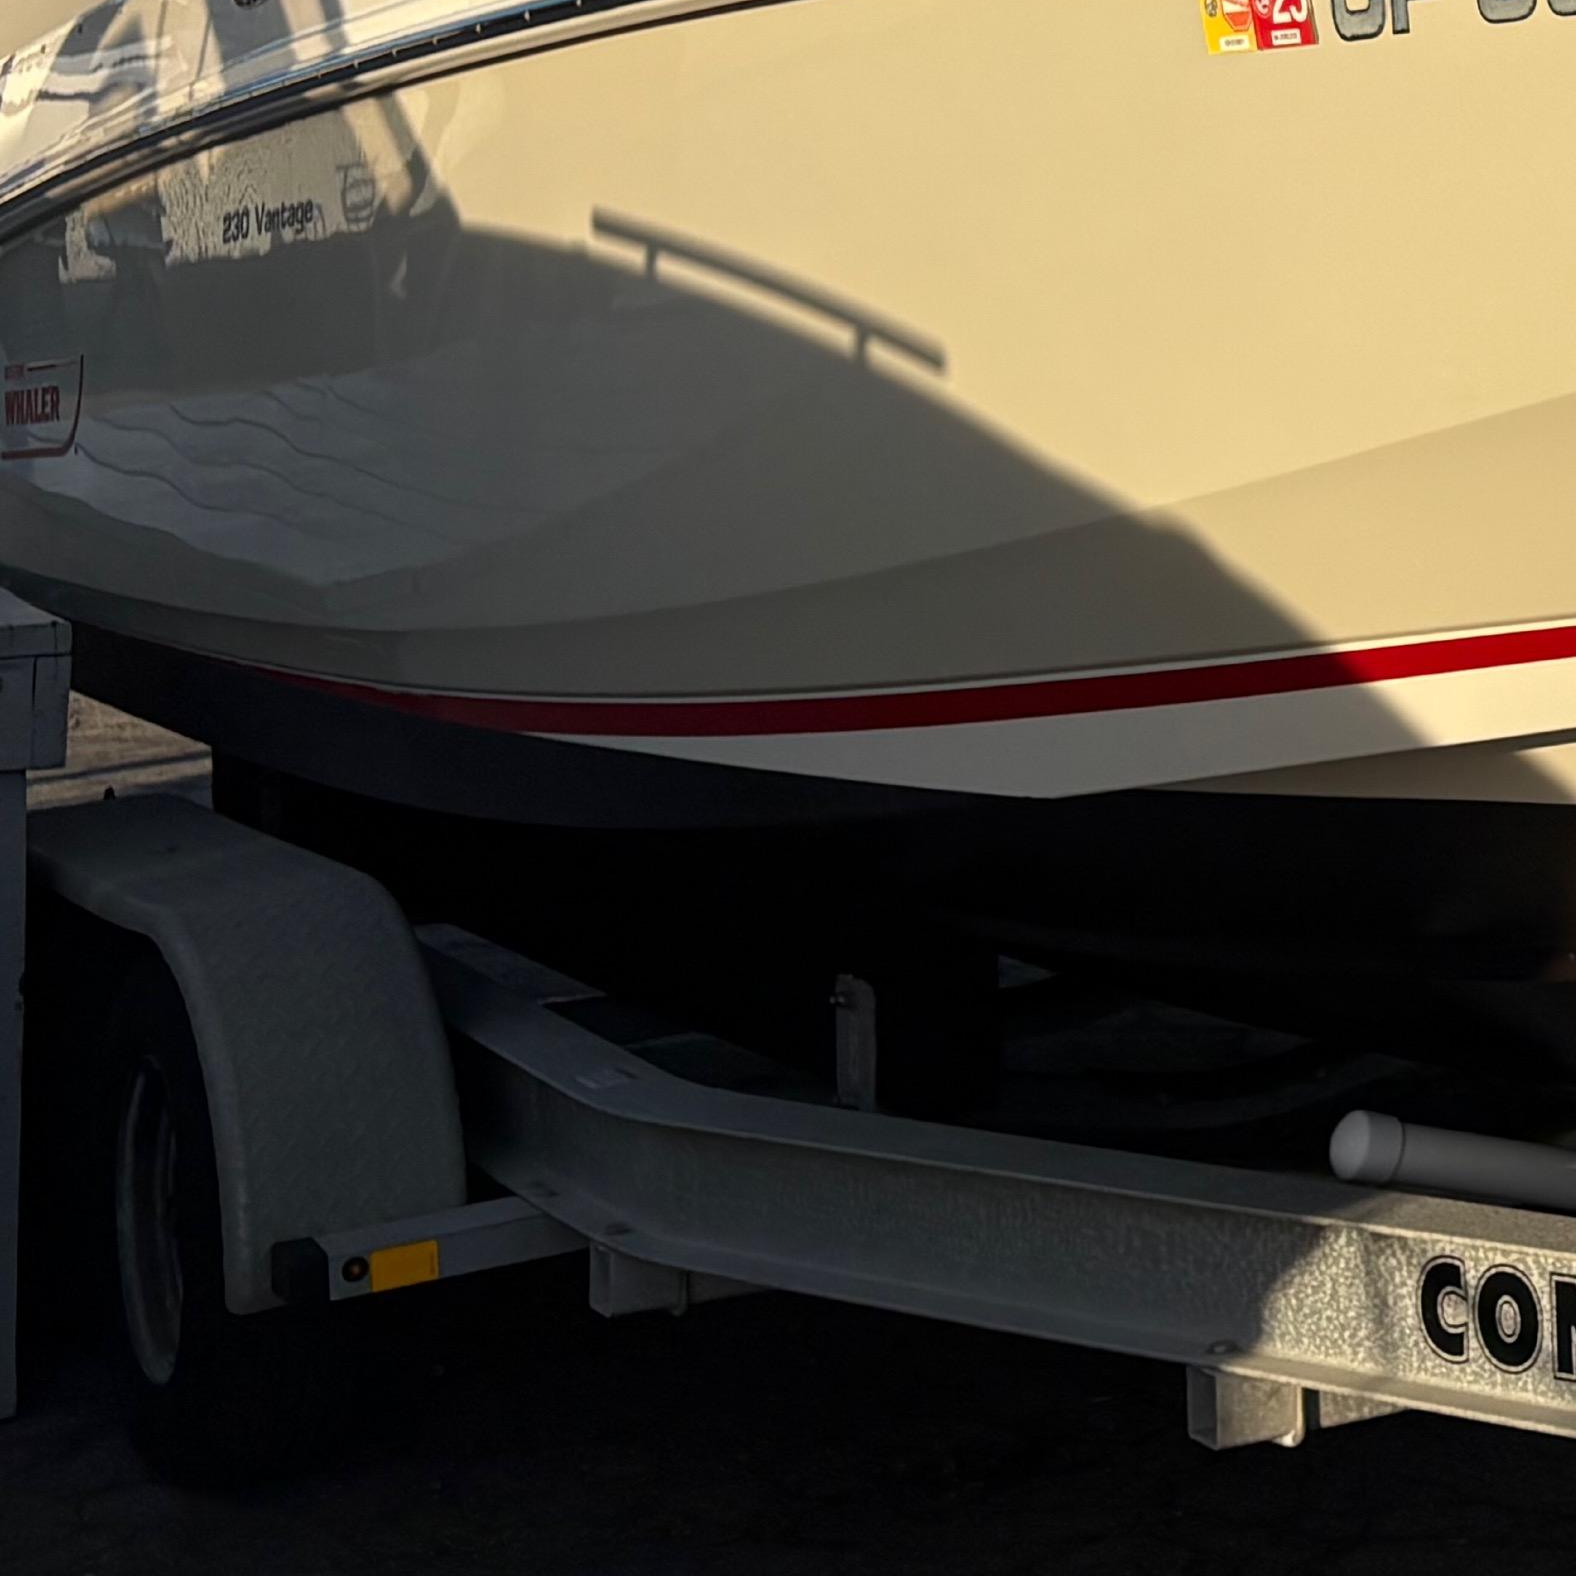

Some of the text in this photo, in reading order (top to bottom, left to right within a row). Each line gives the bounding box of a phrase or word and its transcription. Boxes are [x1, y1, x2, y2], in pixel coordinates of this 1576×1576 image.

[222, 198, 314, 244] 230 Vantage
[4, 385, 60, 426] WHALER
